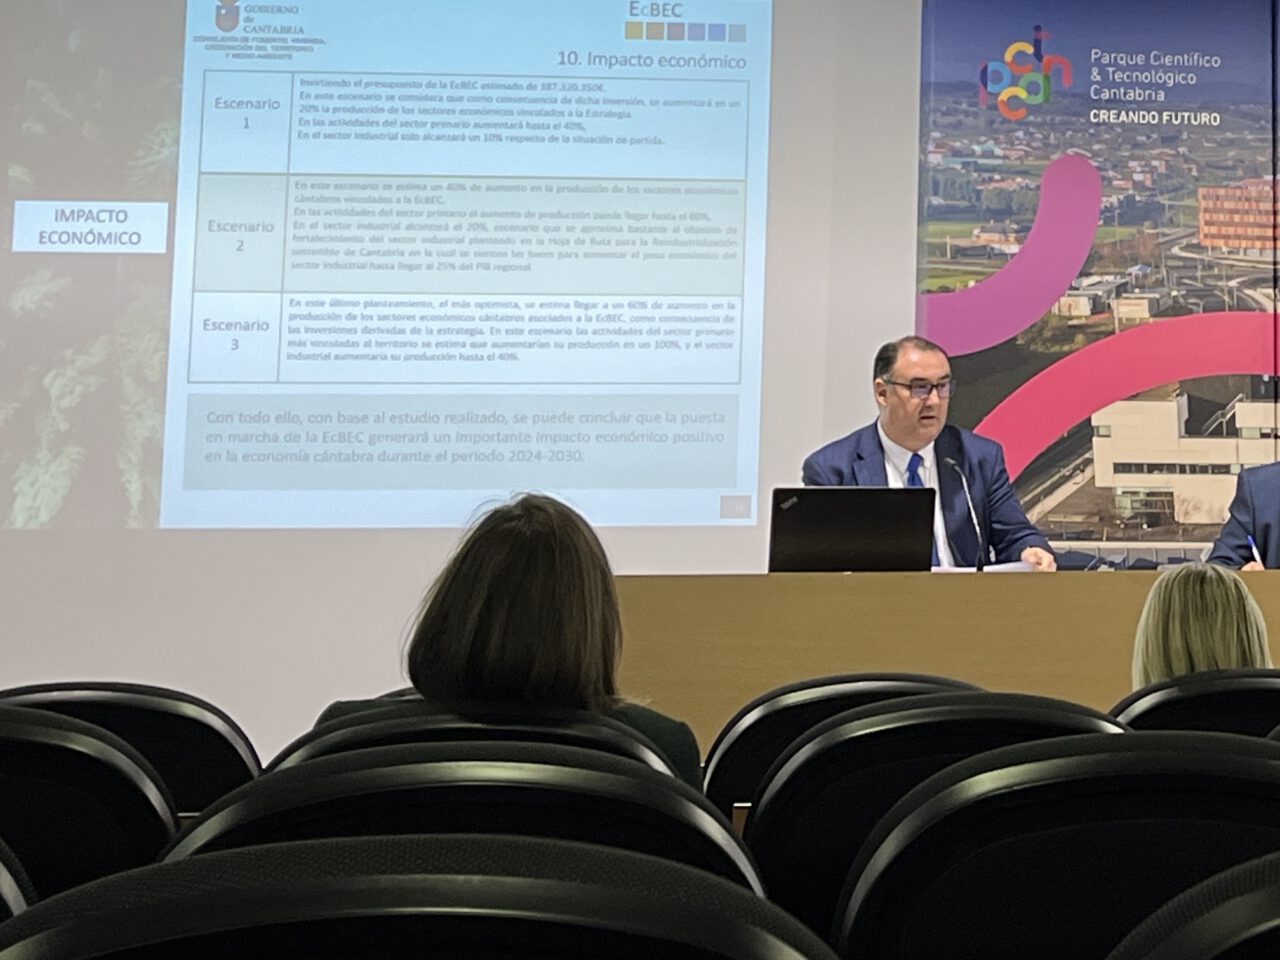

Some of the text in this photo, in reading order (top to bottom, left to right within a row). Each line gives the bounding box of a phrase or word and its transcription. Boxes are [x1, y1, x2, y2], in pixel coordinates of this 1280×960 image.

[244, 5, 299, 14] GOBIERNO
[629, 0, 682, 17] EcBEC
[243, 24, 304, 34] CANTABRIA
[557, 51, 747, 70] 10. Impacto económico
[1091, 49, 1221, 68] Parque Científico
[1091, 68, 1196, 87] & Tecnológico
[1090, 85, 1165, 101] Cantabria
[214, 97, 280, 110] Escenario
[243, 117, 250, 129] 1
[1090, 110, 1220, 126] CREANDO FUTURO
[54, 209, 128, 223] IMPACTO
[208, 220, 274, 233] Escenario
[39, 229, 141, 245] ECONÓMICO
[235, 241, 244, 252] 2
[203, 319, 269, 331] Escenario
[231, 339, 239, 351] 3
[206, 412, 725, 427] Con todo ello, con base al estudio realizado, se puede concluir que la puesta
[206, 431, 725, 446] en marcha de la EcBEC generará un importante impacto económico positivo
[205, 453, 222, 462] en
[226, 450, 238, 462] la
[242, 450, 310, 462] economía
[314, 450, 374, 463] cántabra
[377, 450, 432, 463] durante
[436, 450, 447, 463] el
